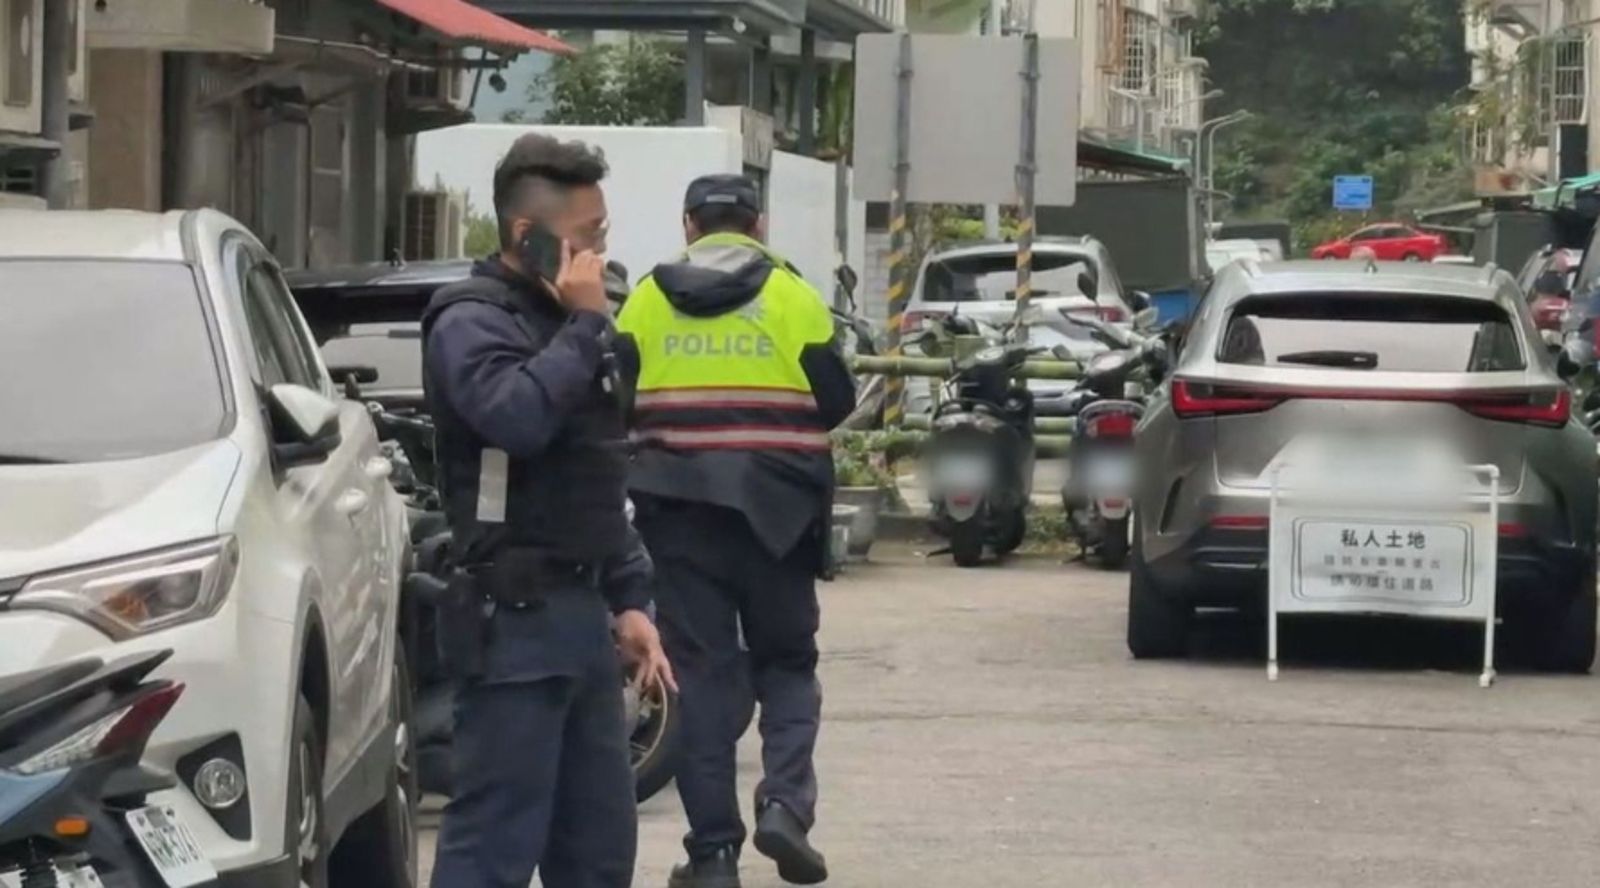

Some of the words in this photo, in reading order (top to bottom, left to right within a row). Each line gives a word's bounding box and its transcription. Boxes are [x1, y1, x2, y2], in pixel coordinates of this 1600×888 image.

[664, 334, 774, 357] POLICE
[1341, 529, 1427, 549] 私人土地
